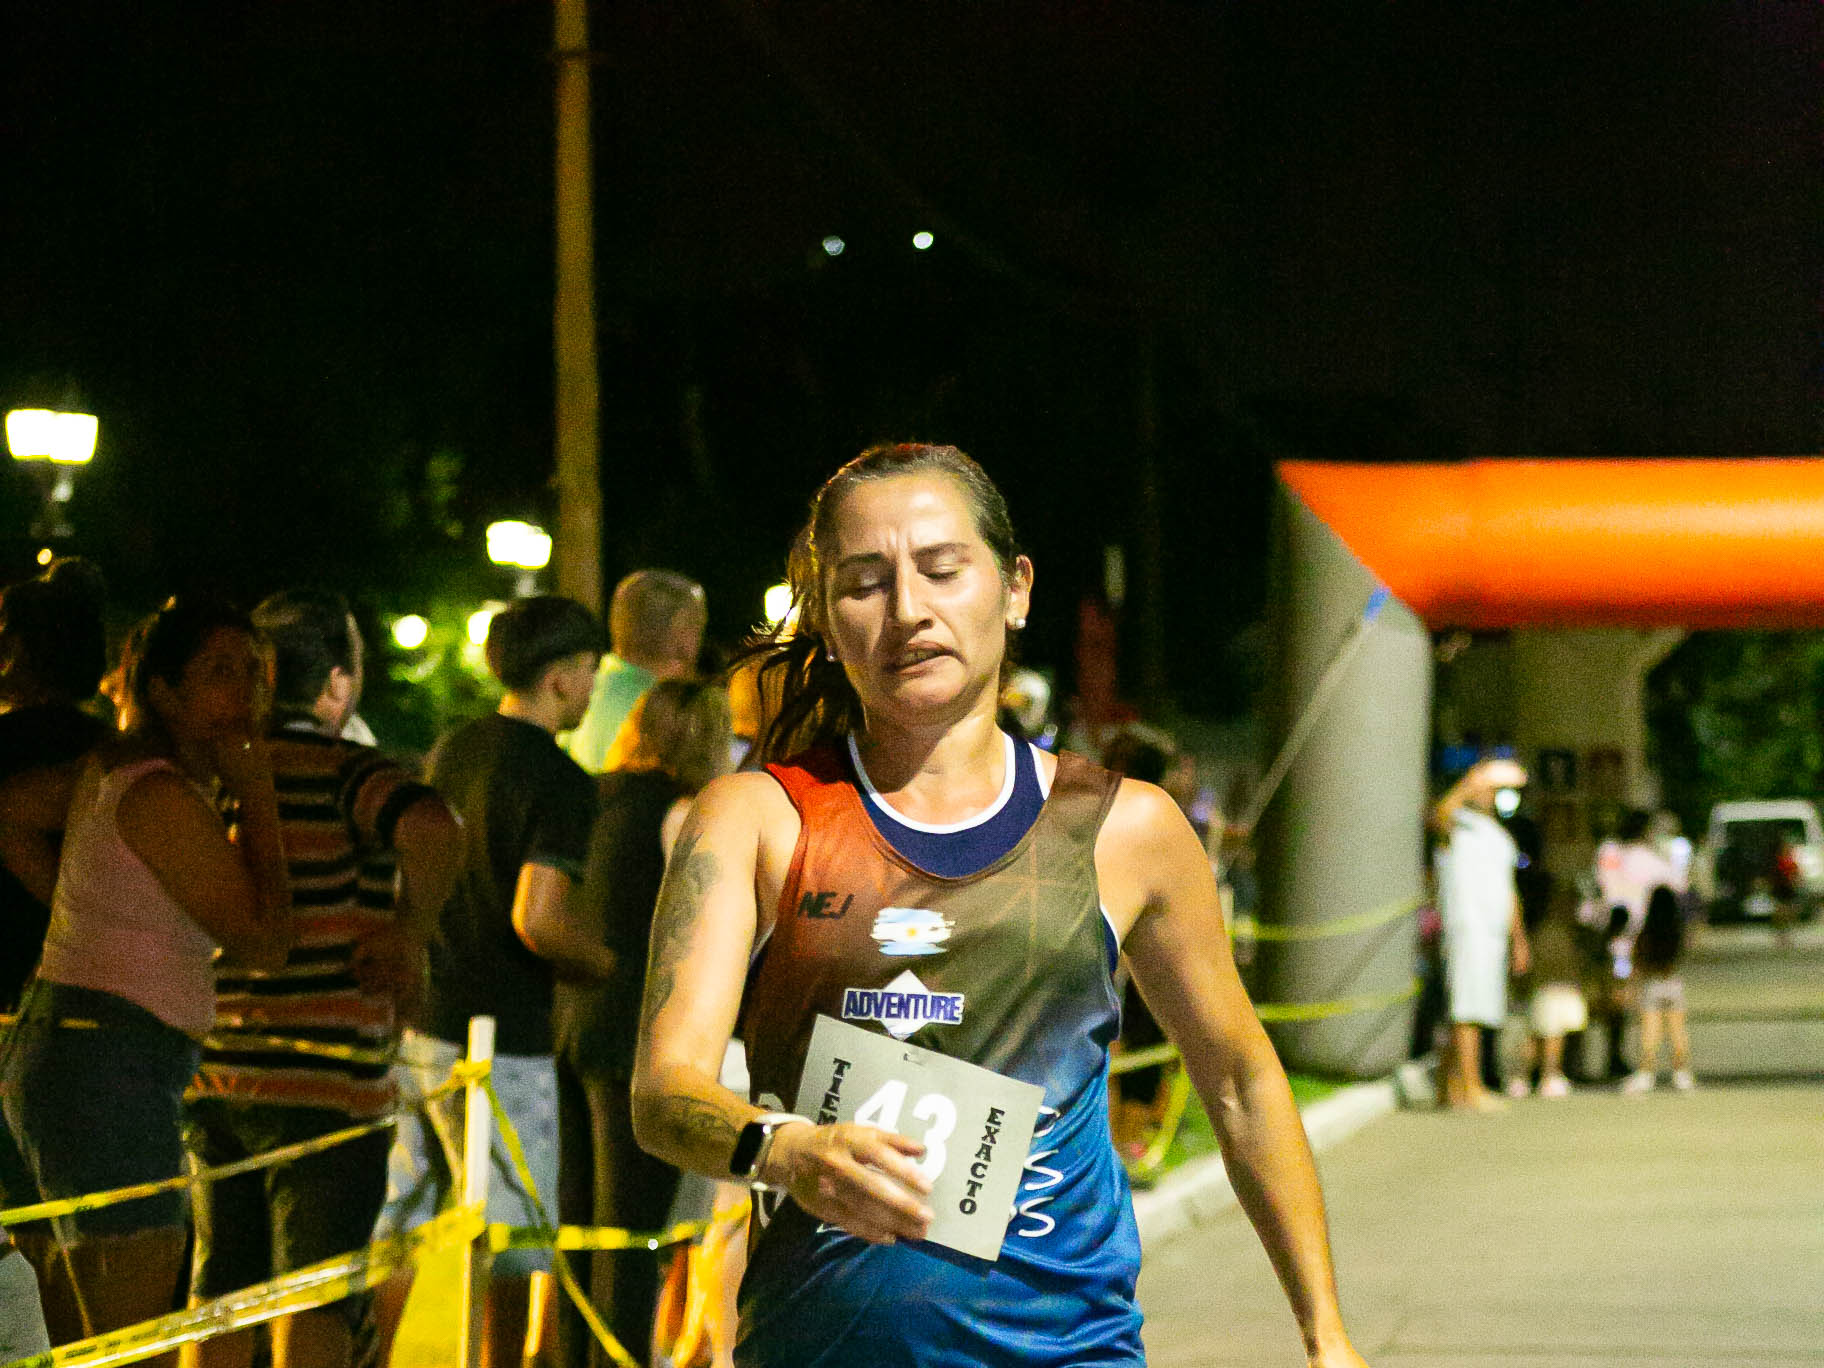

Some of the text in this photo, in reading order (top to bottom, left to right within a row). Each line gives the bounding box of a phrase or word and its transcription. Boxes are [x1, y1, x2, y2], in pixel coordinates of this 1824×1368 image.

[844, 990, 961, 1022] ADVENTURE
[817, 1057, 852, 1126] TIEM
[854, 1079, 957, 1184] 43
[959, 1106, 1006, 1216] EXACTO
